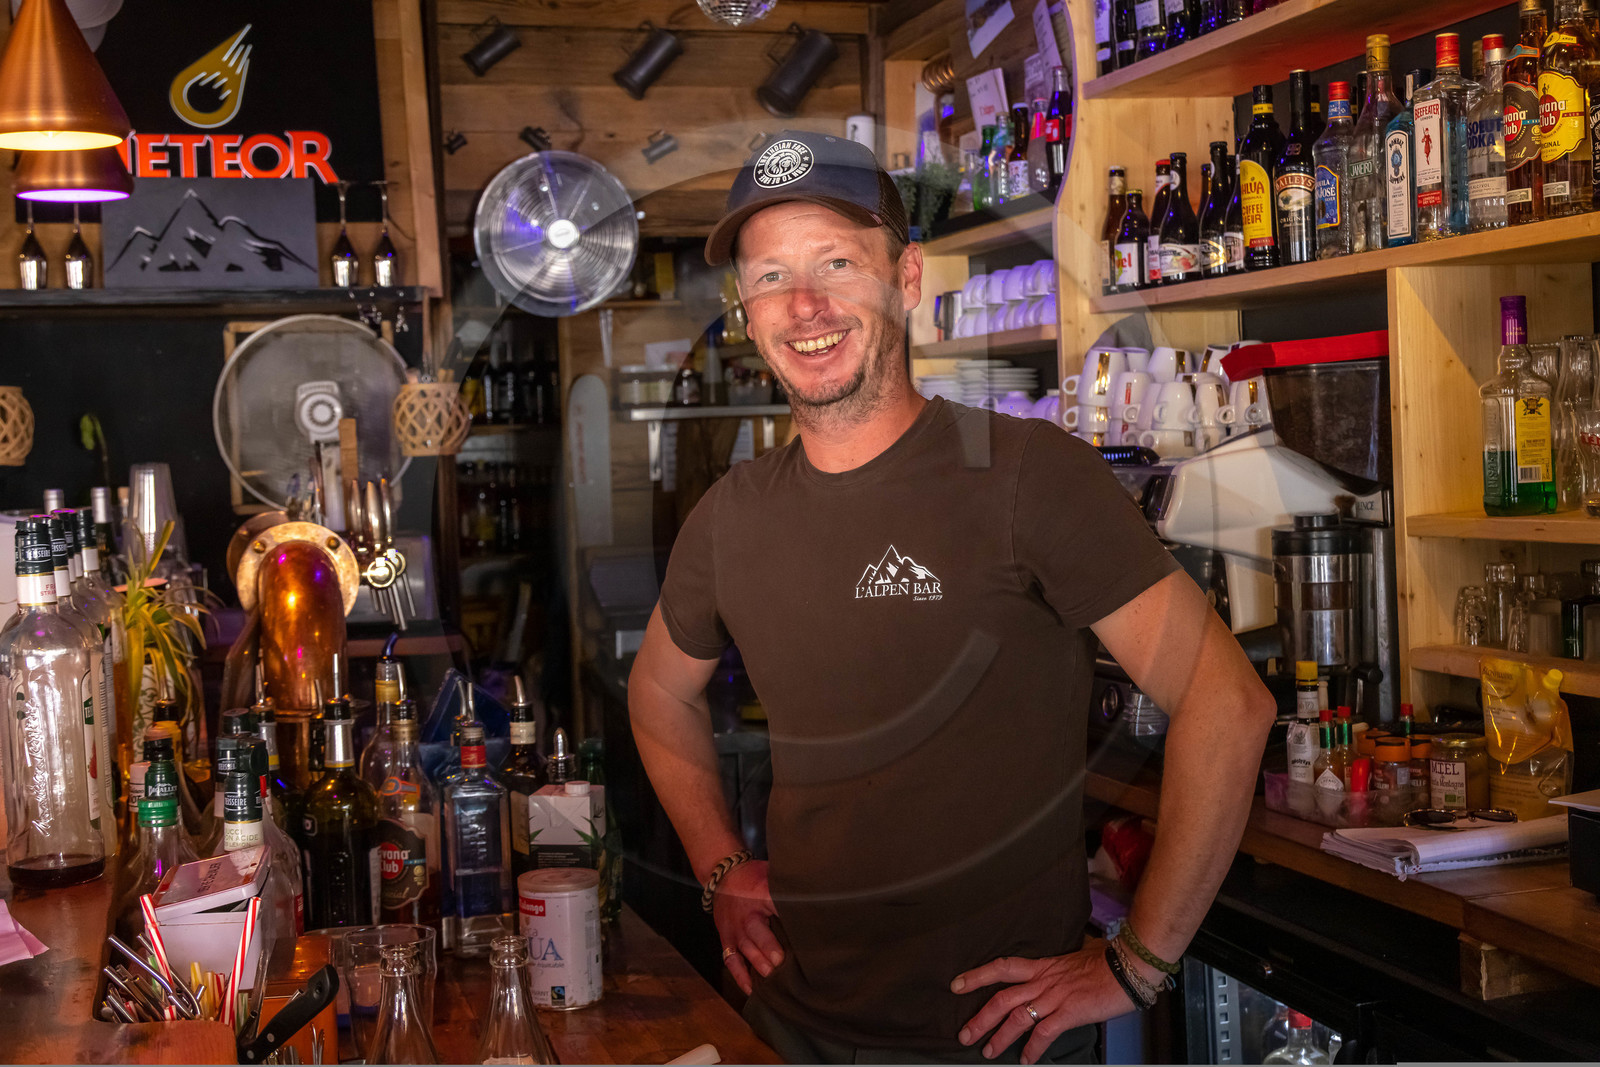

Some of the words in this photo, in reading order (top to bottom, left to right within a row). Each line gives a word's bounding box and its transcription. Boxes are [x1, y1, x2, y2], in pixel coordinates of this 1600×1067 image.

[1414, 103, 1440, 121] BEEFEATER
[758, 150, 769, 168] THE
[767, 142, 792, 156] INDIAN
[791, 143, 808, 156] FACE
[783, 174, 793, 183] TO
[791, 163, 810, 179] BORN
[771, 177, 782, 185] BE
[1276, 175, 1313, 190] BAILEYS
[855, 583, 909, 599] L'ALPEN
[912, 582, 943, 595] BAR
[1431, 761, 1460, 775] MIEL
